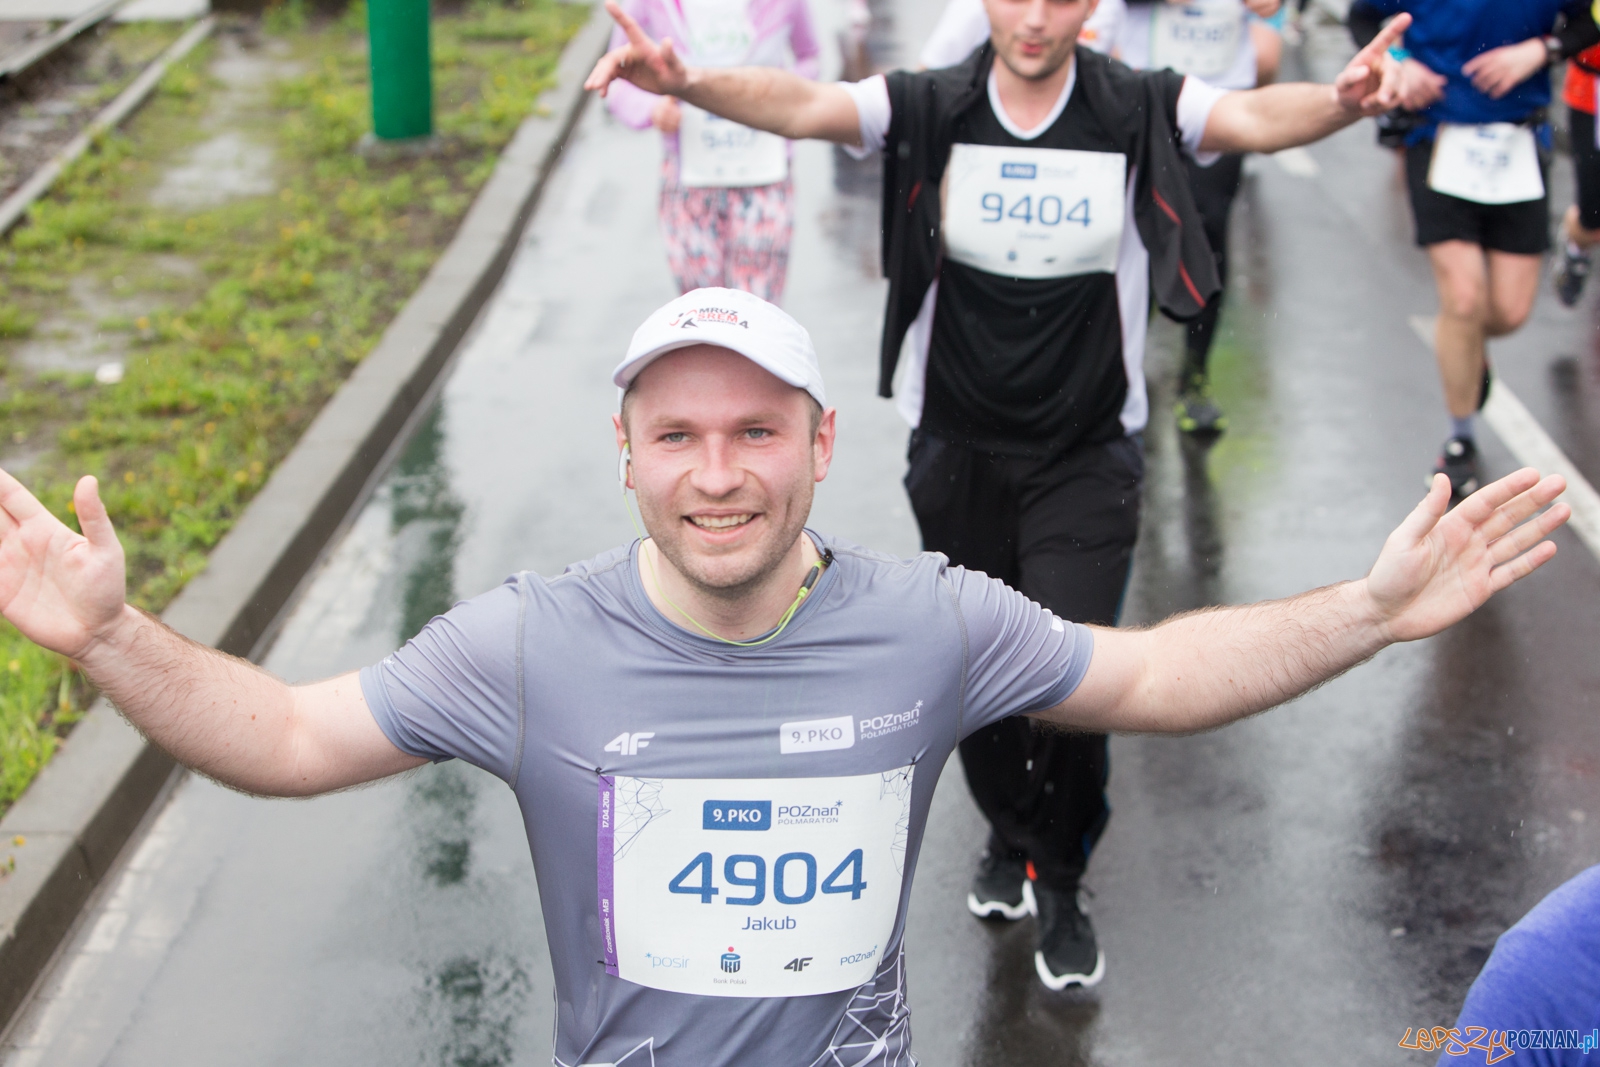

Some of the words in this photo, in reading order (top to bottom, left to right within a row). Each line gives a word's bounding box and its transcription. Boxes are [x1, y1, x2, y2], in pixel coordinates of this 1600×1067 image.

[981, 192, 1091, 228] 9404
[604, 732, 655, 755] 4F
[808, 727, 843, 742] PKO
[602, 790, 610, 829] 17.04.2016
[728, 808, 762, 823] PKO
[668, 848, 867, 906] 4904
[741, 916, 797, 931] Jakub
[783, 957, 813, 972] 4F
